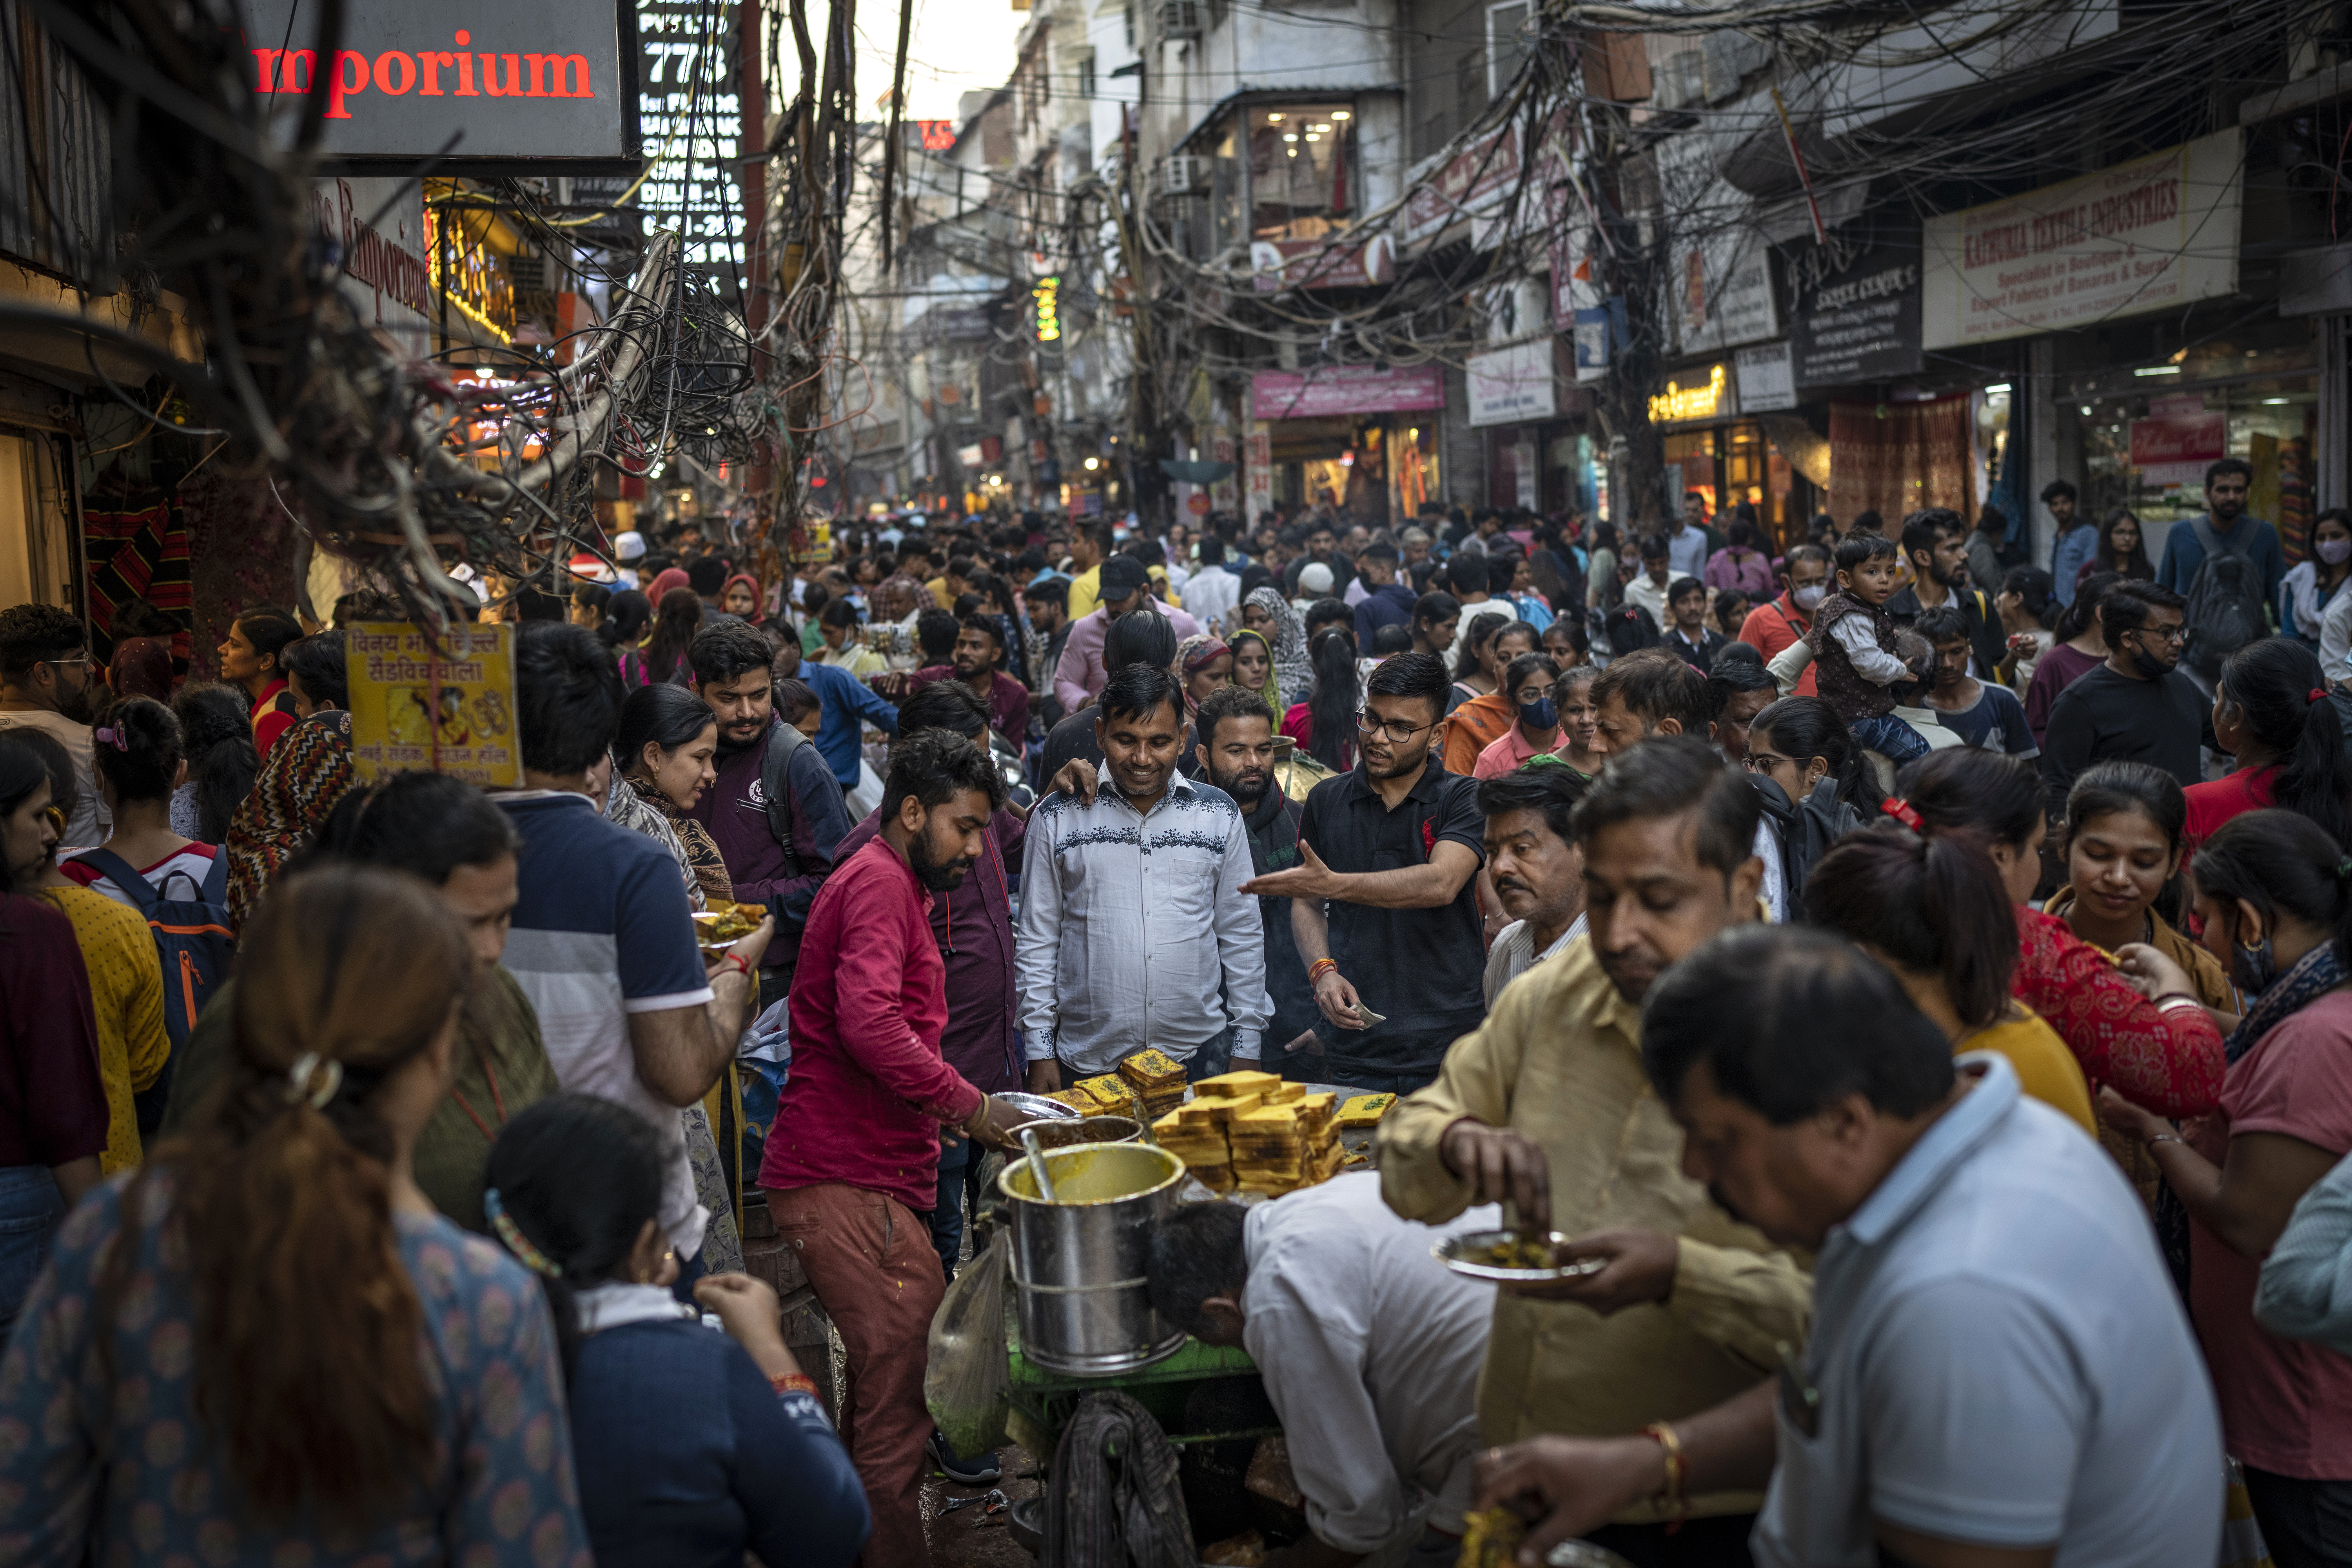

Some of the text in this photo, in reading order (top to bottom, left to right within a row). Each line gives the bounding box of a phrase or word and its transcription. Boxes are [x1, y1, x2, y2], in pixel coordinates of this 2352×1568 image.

[220, 28, 595, 119] mporium
[2033, 204, 2086, 254] TEXTILE
[2091, 178, 2178, 240] INDUSTRIES
[337, 177, 428, 323] Emporium
[1998, 263, 2052, 289] Specialist
[2054, 261, 2066, 276] in
[2009, 283, 2049, 305] Fabrics
[2053, 279, 2065, 296] of
[2069, 272, 2117, 294] Banaras
[352, 628, 399, 653] विनय
